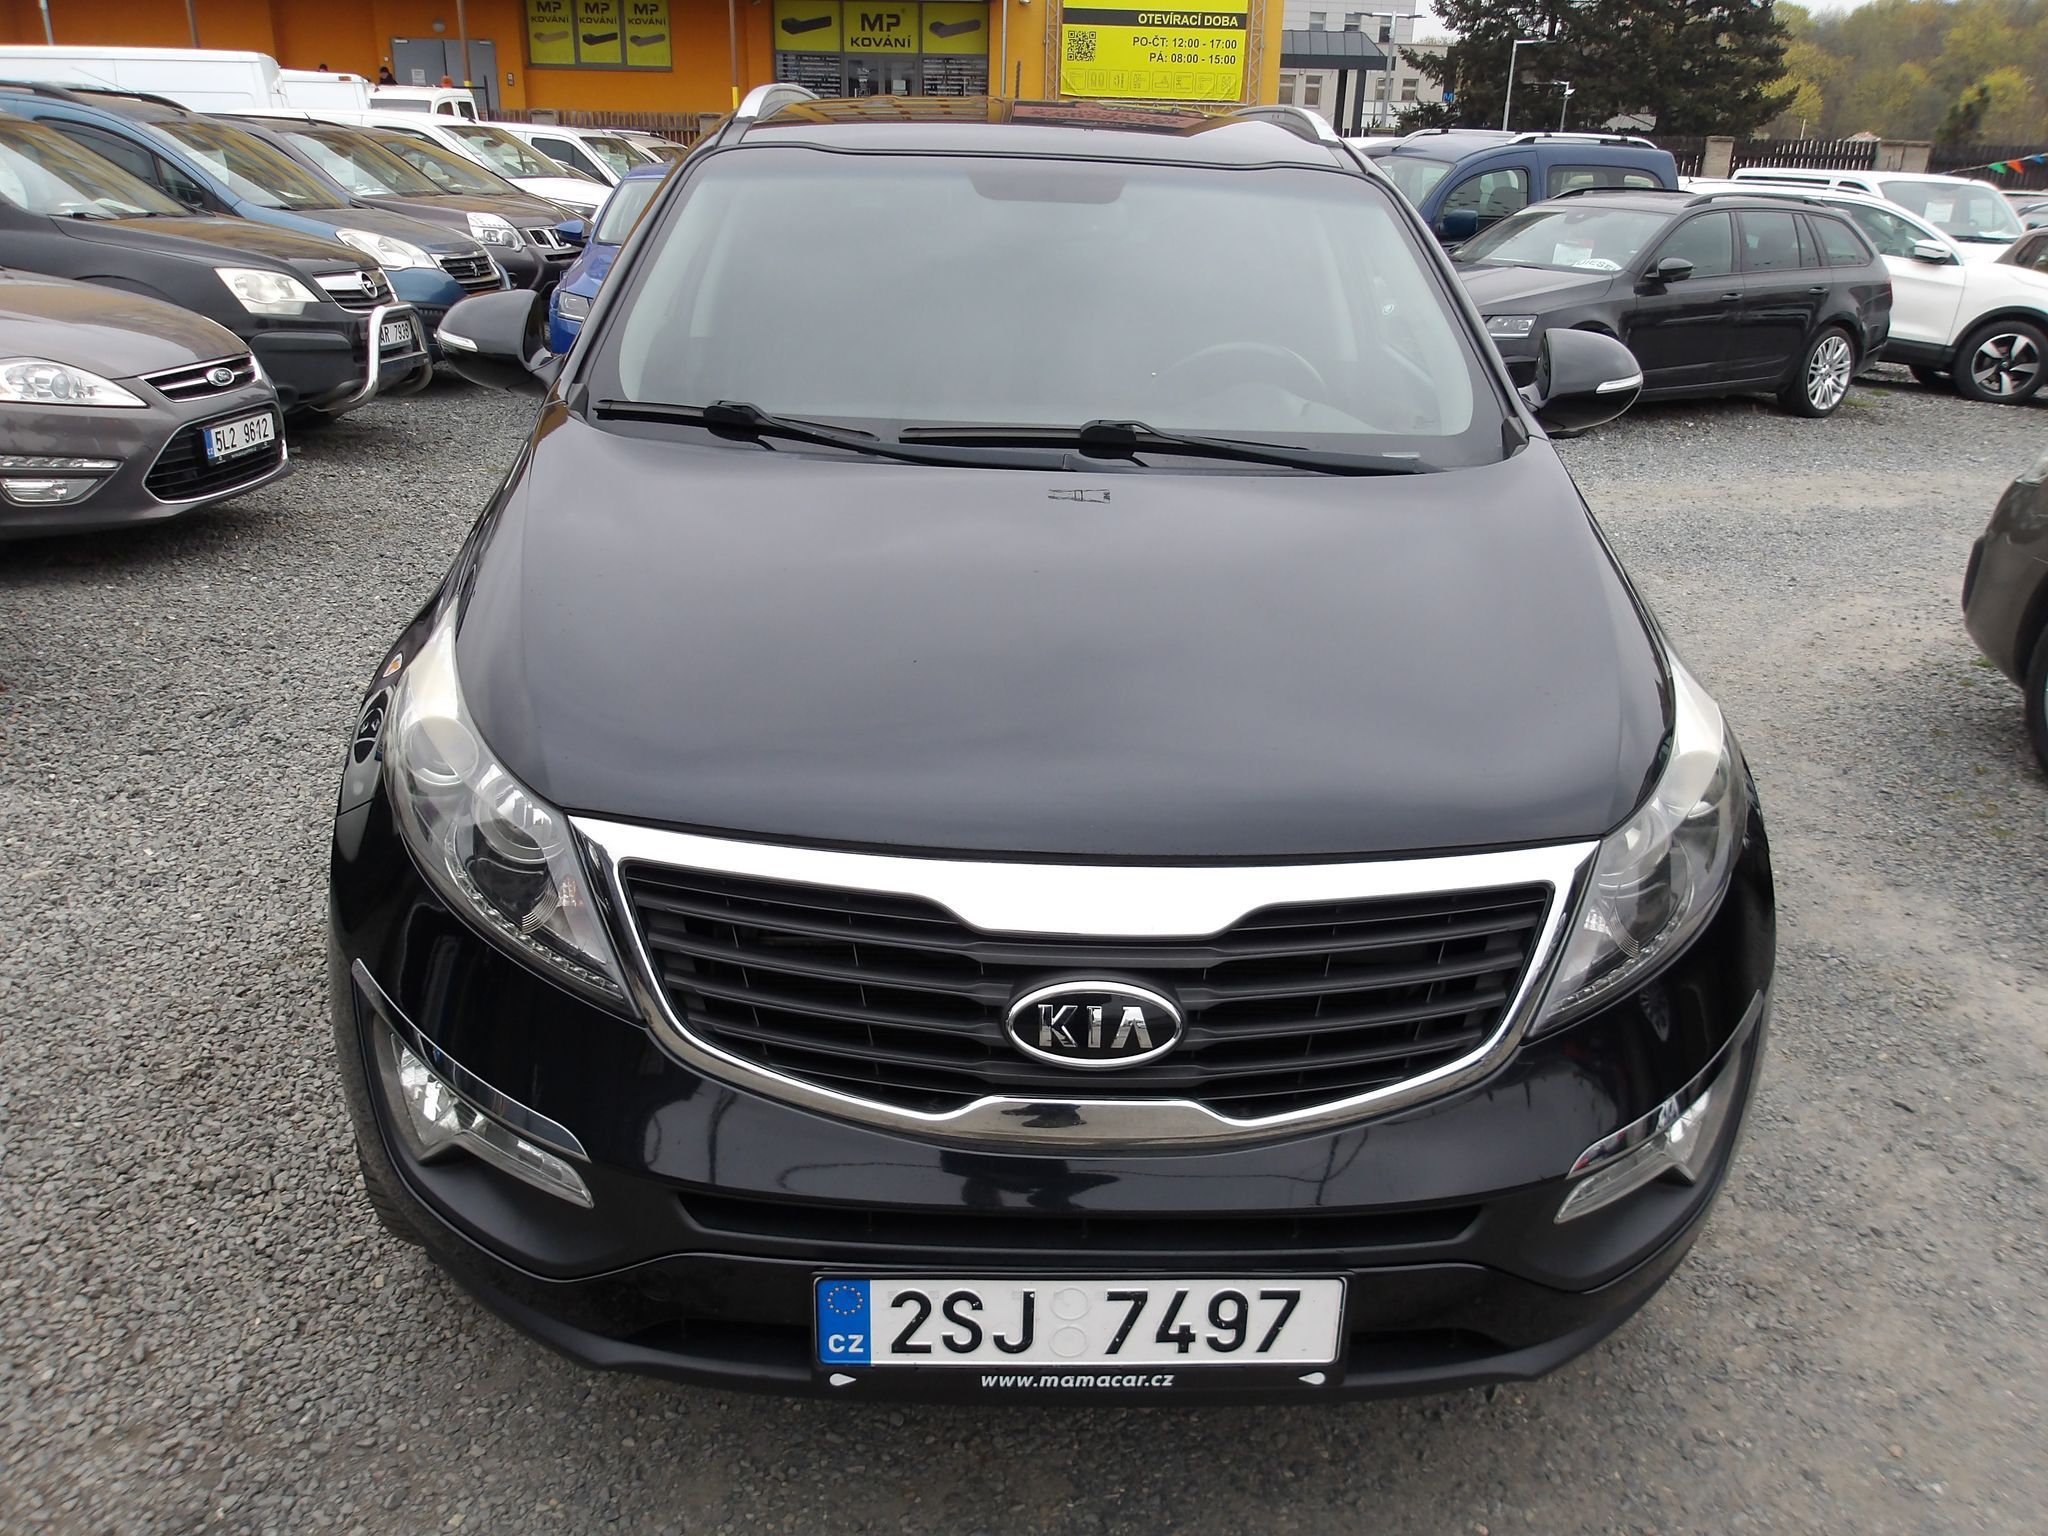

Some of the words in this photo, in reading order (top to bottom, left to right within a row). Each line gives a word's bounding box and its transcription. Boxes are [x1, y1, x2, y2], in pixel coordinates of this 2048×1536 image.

[536, 1, 562, 13] MP
[584, 3, 610, 14] MP
[633, 3, 659, 15] MP
[530, 15, 569, 24] KOVÁNÍ
[579, 16, 617, 25] KOVÁNÍ
[628, 17, 666, 26] KOVÁNÍ
[860, 13, 901, 32] MP
[1137, 12, 1202, 26] OTEVÍRACÍ
[1204, 15, 1239, 27] DOBA
[850, 35, 912, 48] KOVÁNÍ
[1132, 35, 1169, 48] PO-ČT:
[1172, 38, 1200, 48] 12:00
[1210, 39, 1237, 49] 17:00
[1149, 51, 1168, 63] PÁ:
[1171, 53, 1198, 63] 08:00
[1208, 54, 1236, 65] 15:00
[214, 427, 238, 452] 5L2
[243, 418, 269, 443] 9612
[1037, 1004, 1153, 1049] KIA
[889, 1288, 1037, 1355] 2SJ
[1103, 1288, 1302, 1355] 7497
[827, 1333, 865, 1354] CZ
[980, 1372, 1175, 1389] www.mamacar.cz
